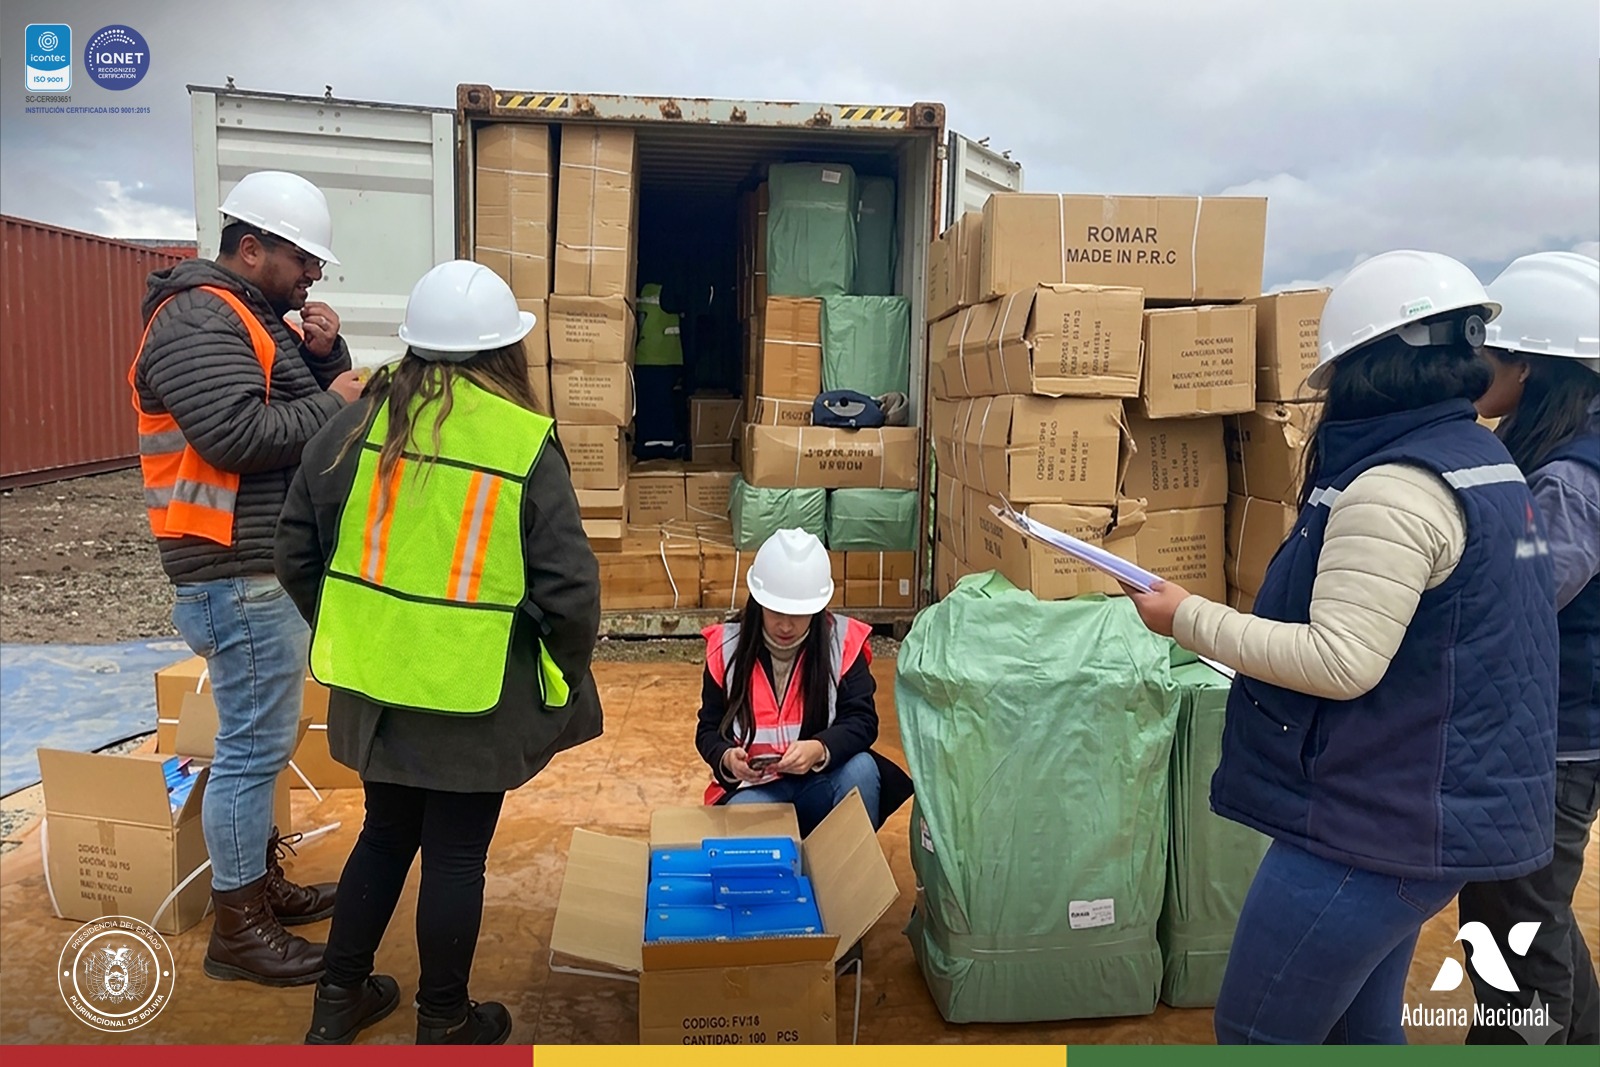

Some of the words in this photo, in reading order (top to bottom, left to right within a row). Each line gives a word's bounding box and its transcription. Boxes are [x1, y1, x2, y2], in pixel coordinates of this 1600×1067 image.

[1087, 226, 1158, 244] ROMAR
[1066, 248, 1112, 263] MADE
[1117, 249, 1132, 263] IN
[1136, 250, 1176, 264] P.R.C
[682, 1016, 730, 1029] CODIGO:
[682, 1033, 743, 1045] CANTIDAD:
[749, 1032, 766, 1044] 100
[777, 1030, 799, 1042] PCS
